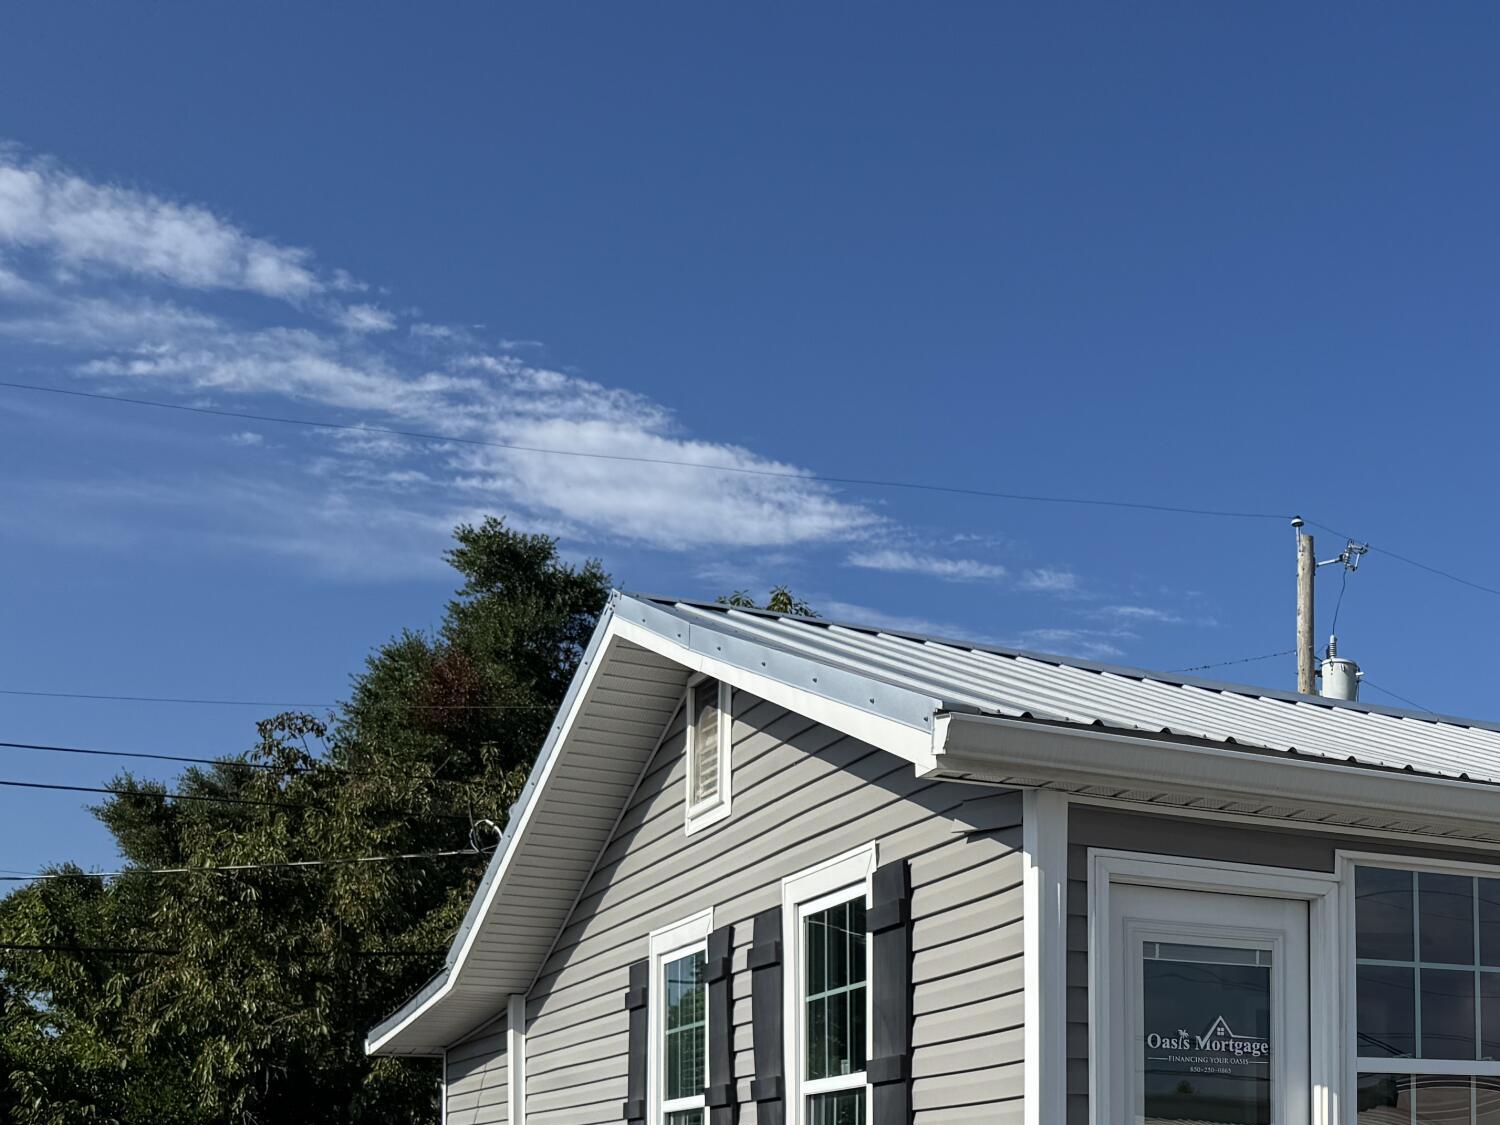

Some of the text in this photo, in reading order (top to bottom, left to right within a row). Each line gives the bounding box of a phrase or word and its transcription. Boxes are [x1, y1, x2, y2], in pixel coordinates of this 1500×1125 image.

[1147, 1033, 1269, 1056] Oasis Mortgage
[1168, 1055, 1208, 1063] FINANCING
